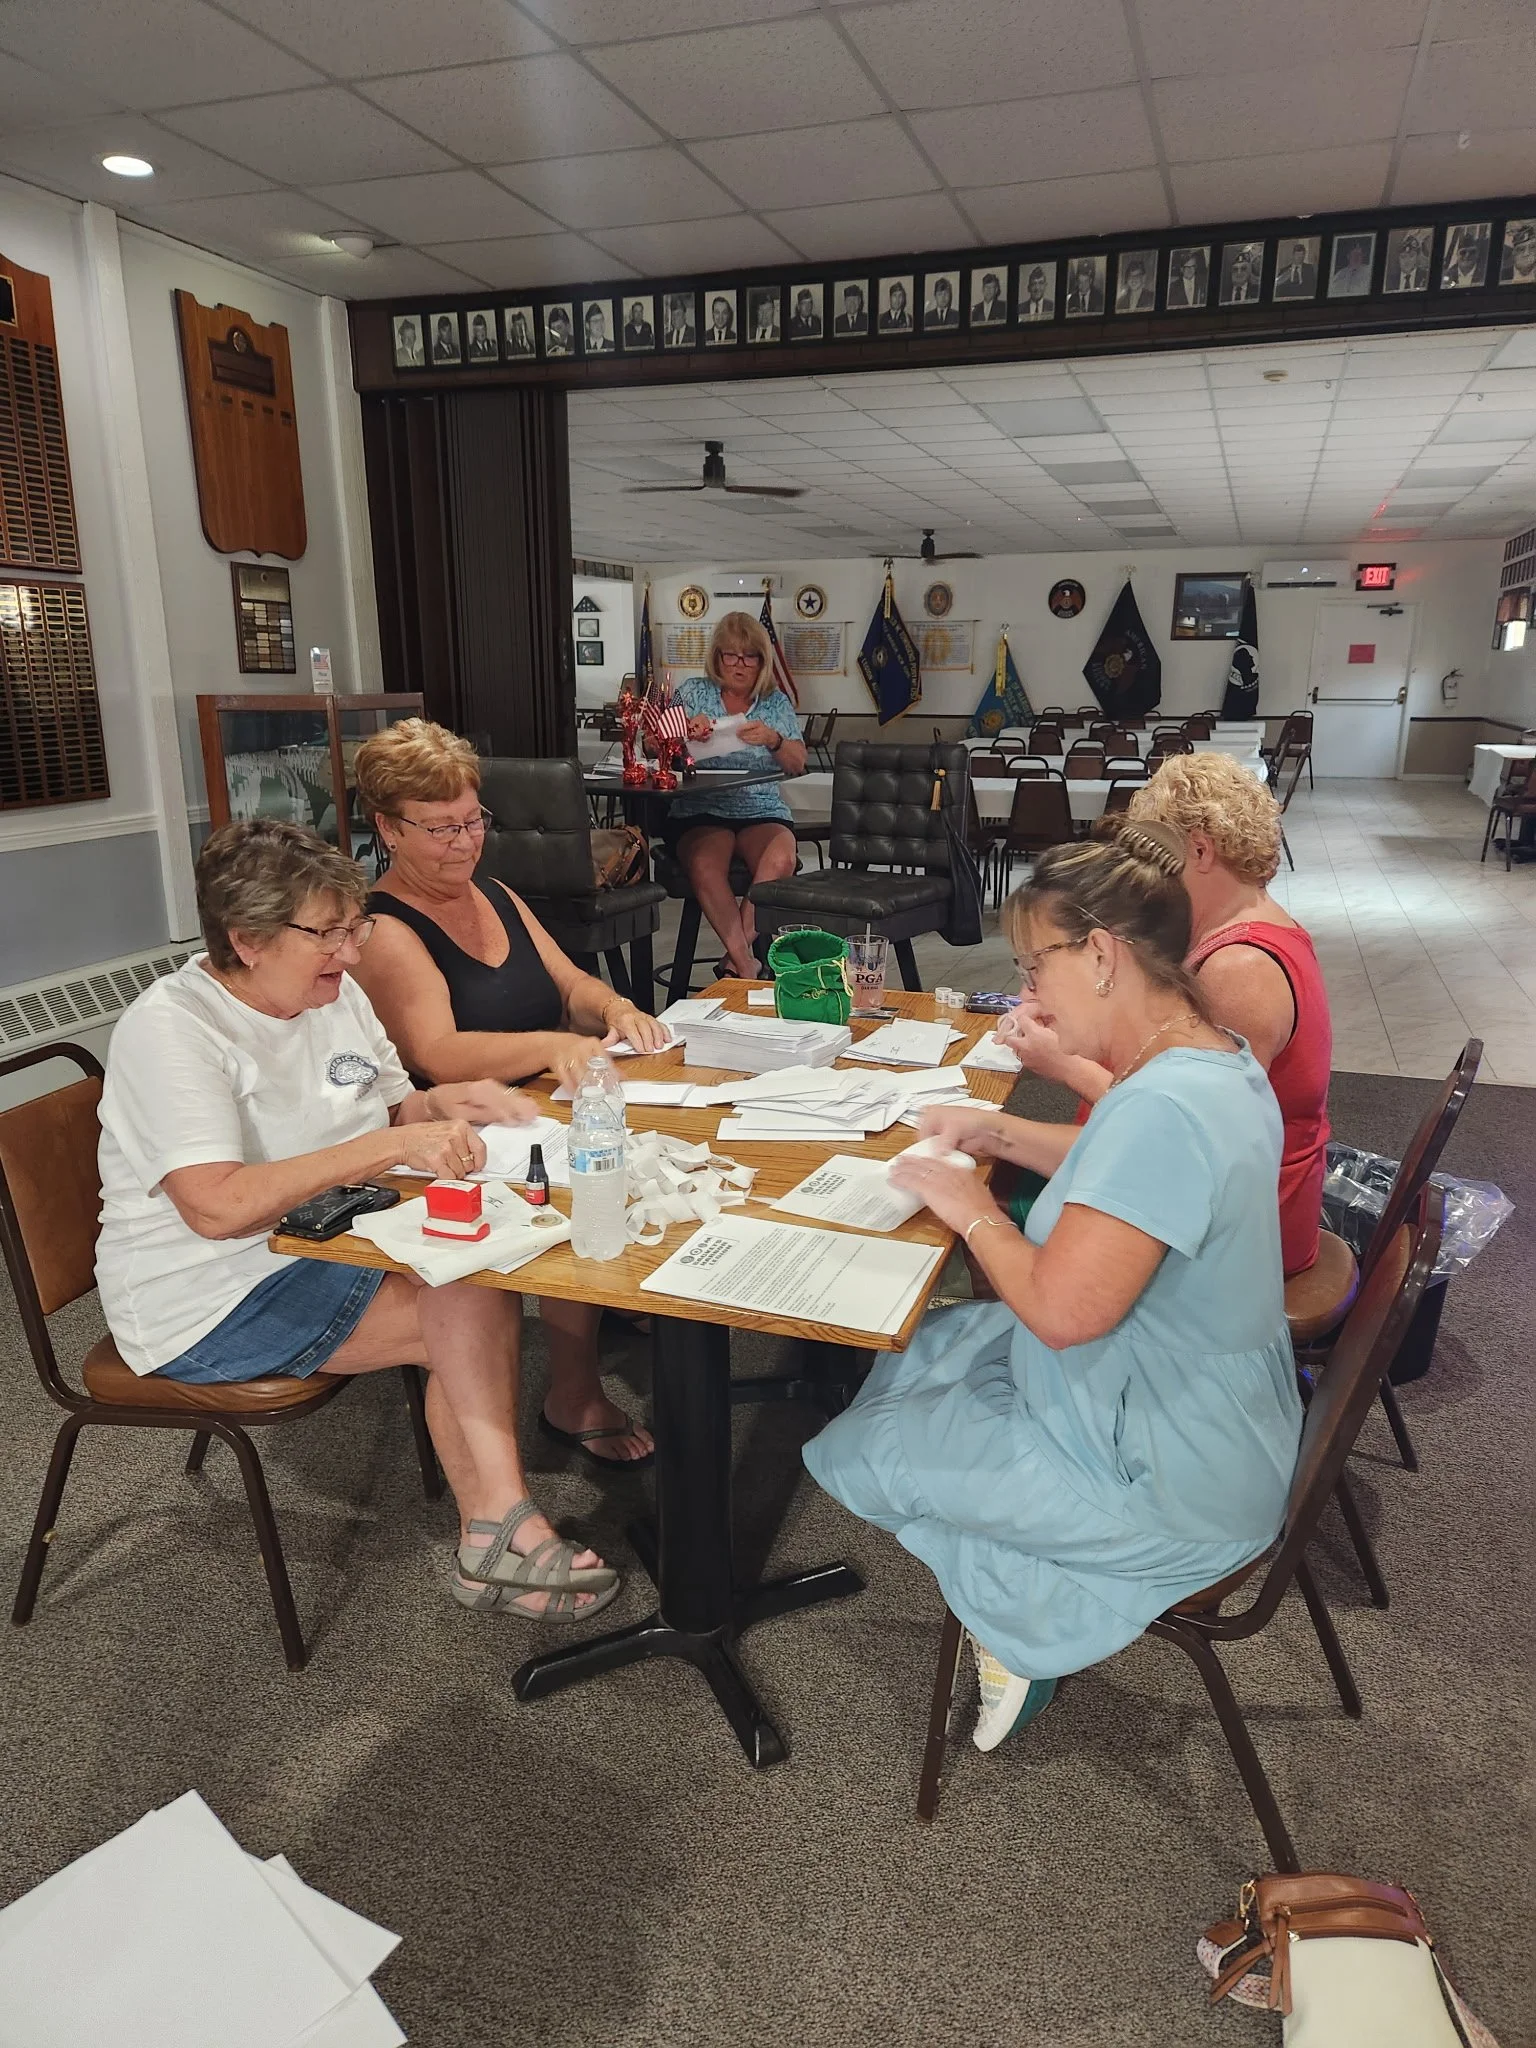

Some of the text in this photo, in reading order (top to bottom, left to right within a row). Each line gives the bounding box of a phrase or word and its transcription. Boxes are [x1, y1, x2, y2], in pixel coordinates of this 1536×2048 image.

[1365, 567, 1389, 584] EXIT
[855, 973, 883, 983] PGA
[330, 1055, 365, 1079] AMERICAN
